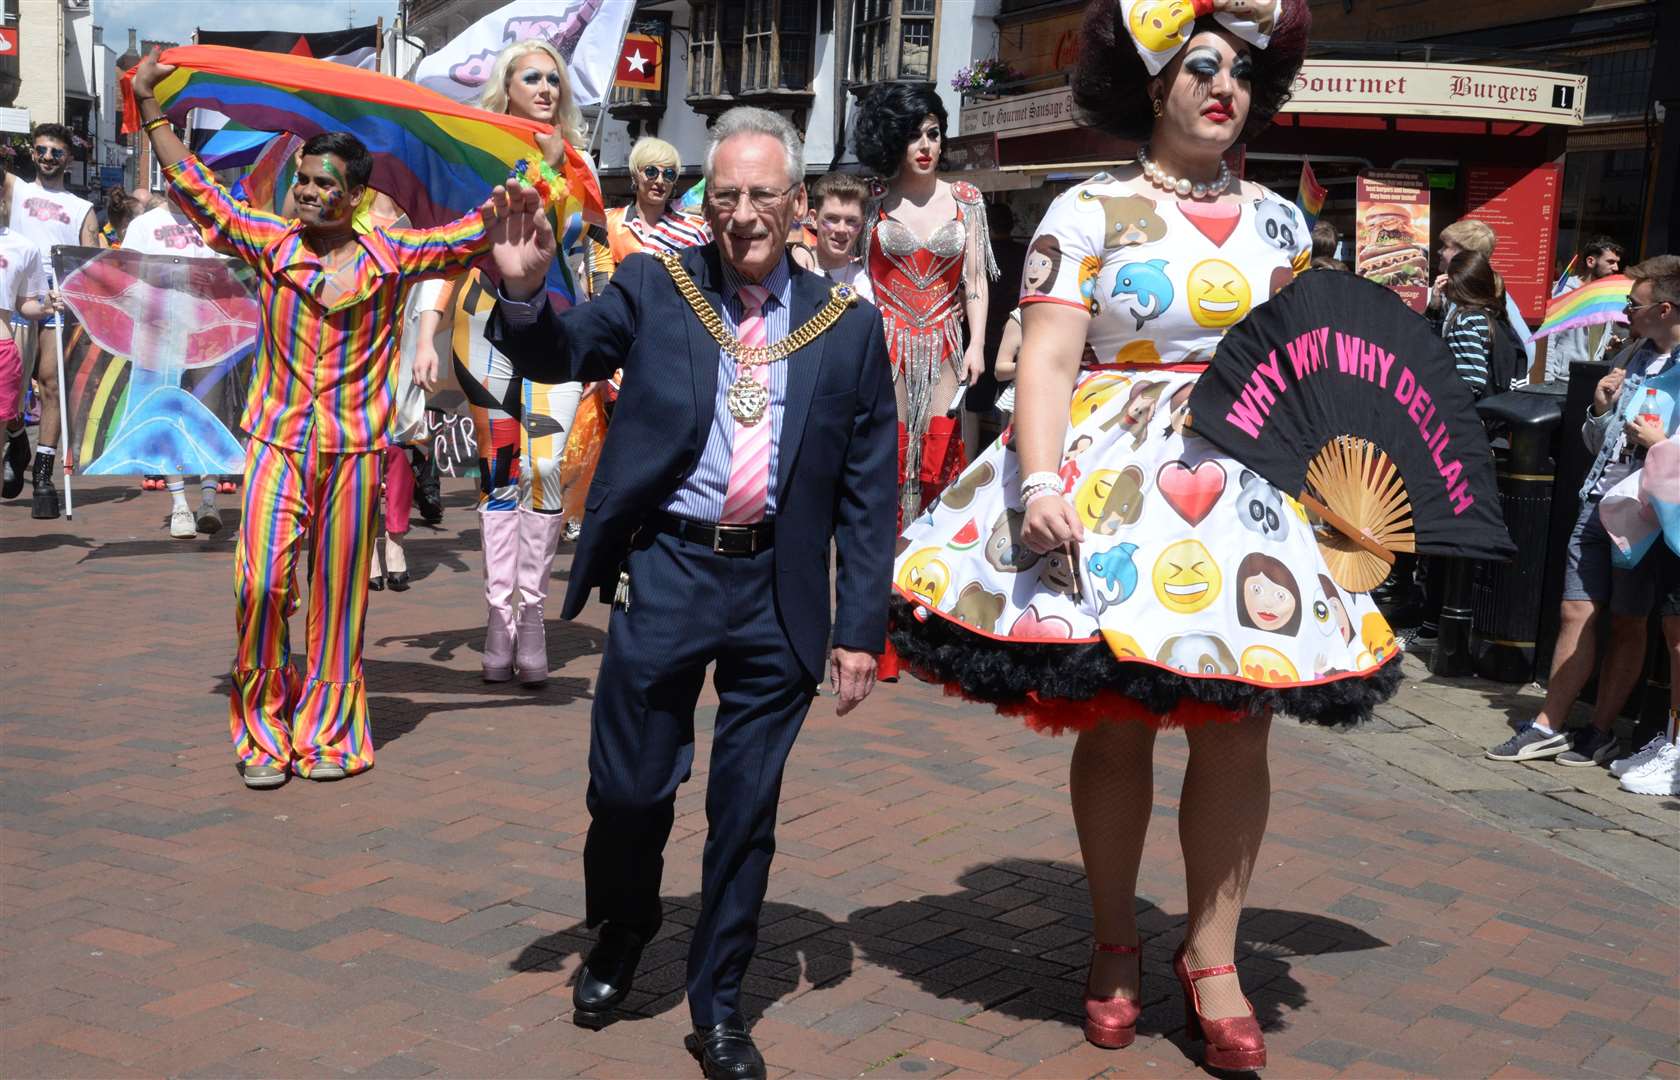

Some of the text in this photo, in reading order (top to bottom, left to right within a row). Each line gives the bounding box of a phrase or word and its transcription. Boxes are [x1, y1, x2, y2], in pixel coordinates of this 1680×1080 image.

[1293, 73, 1538, 103] Gourmet Burgers
[1560, 87, 1567, 108] 1
[982, 111, 994, 127] The
[996, 107, 1027, 126] Gourmet
[1029, 101, 1063, 119] Sausage
[1225, 326, 1475, 517] WHY WHY WHY DELILAH
